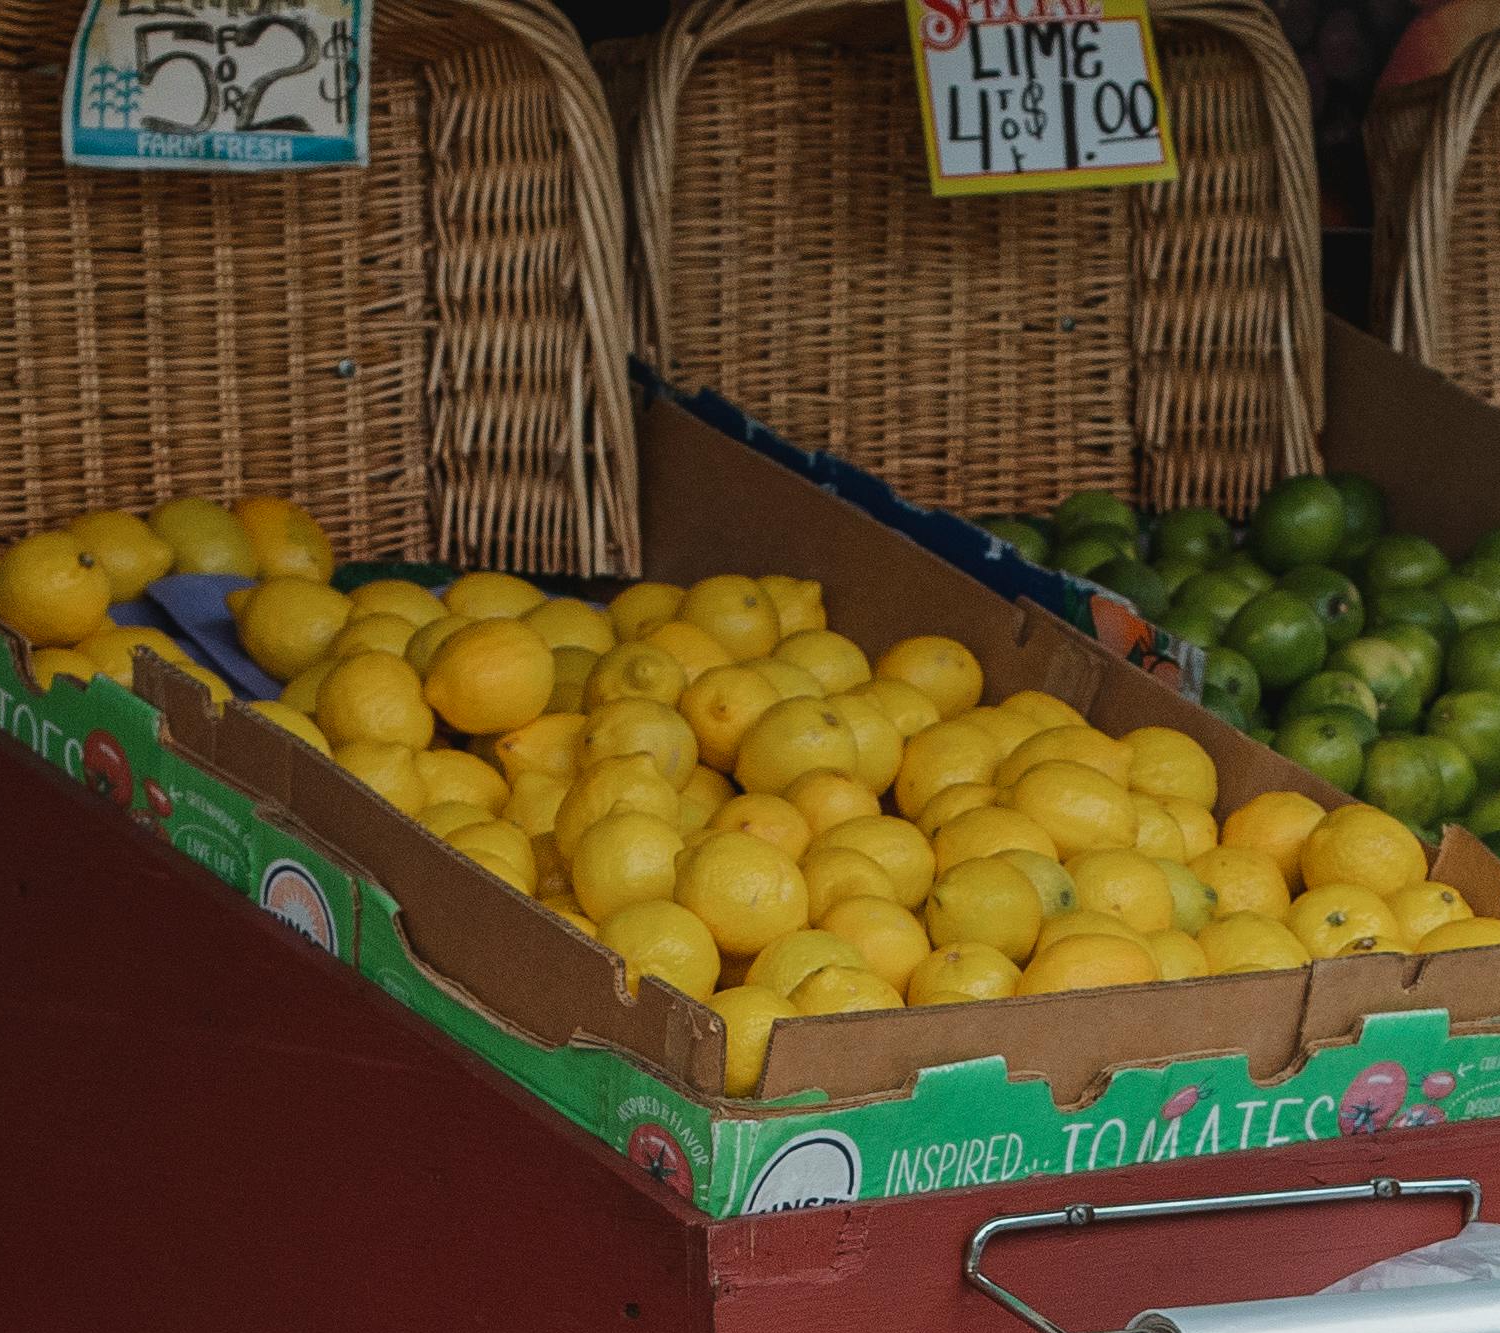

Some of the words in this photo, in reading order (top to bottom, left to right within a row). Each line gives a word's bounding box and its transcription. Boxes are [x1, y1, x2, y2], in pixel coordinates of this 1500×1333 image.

[969, 20, 1103, 80] LIME
[137, 135, 204, 160] FARM
[211, 136, 294, 162] FRESH
[947, 84, 992, 171] 4
